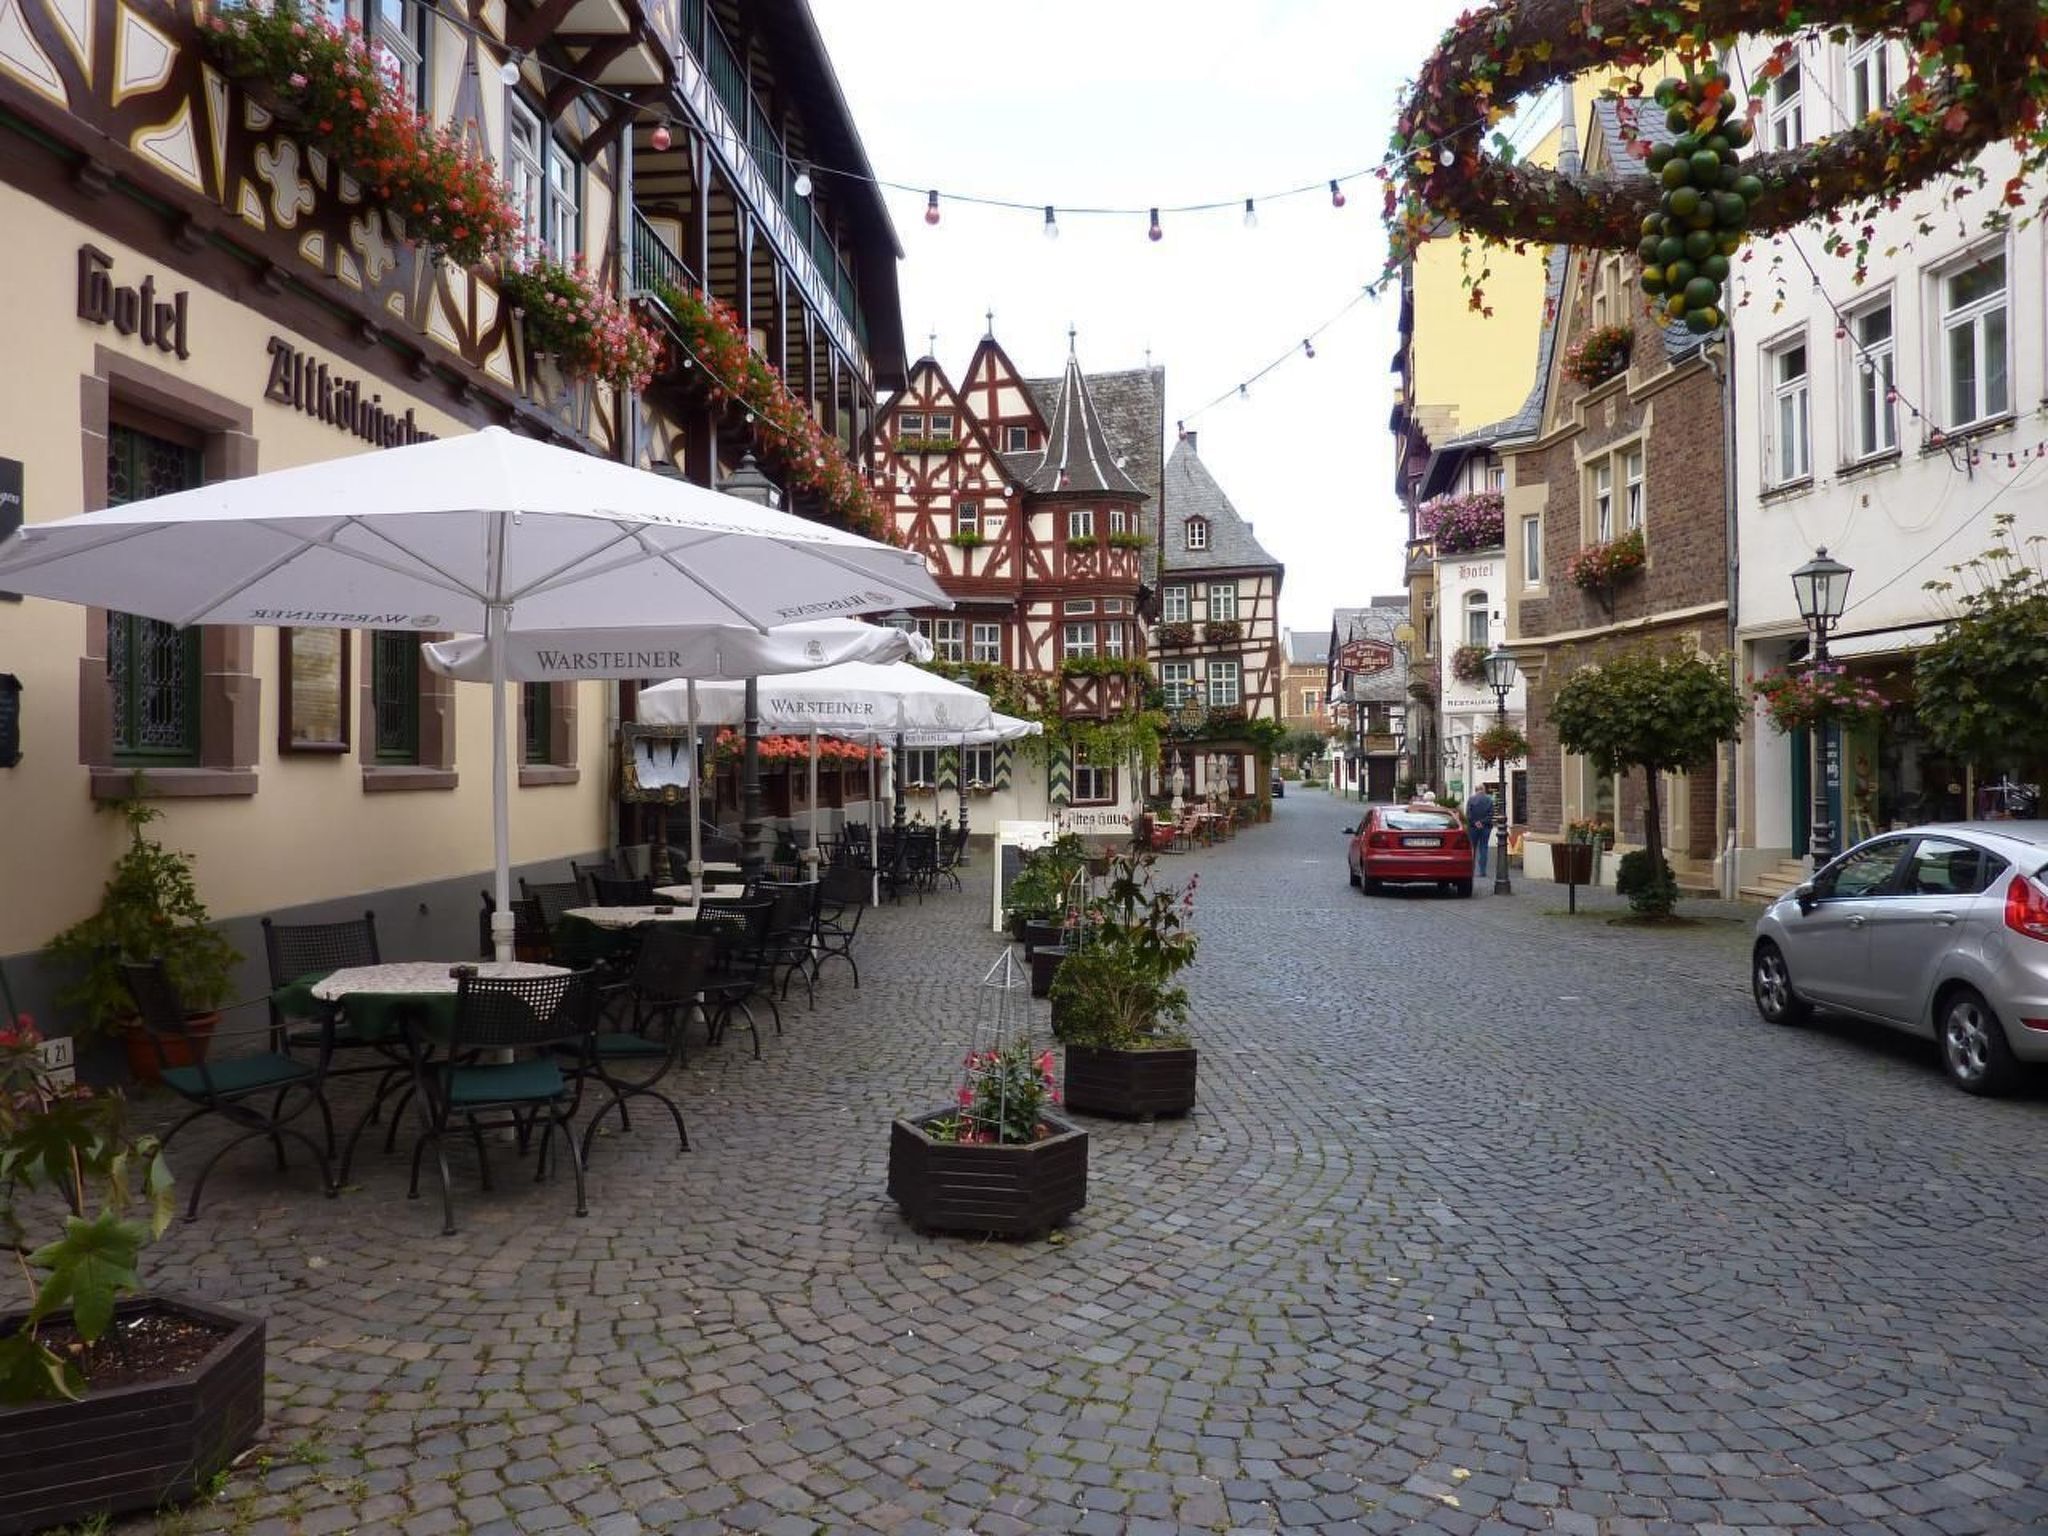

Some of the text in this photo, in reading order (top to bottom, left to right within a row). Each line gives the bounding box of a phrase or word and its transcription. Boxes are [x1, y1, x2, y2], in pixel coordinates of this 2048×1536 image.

[77, 243, 190, 361] Hotel
[264, 335, 440, 449] Altkölnisch
[1458, 562, 1494, 580] Hotel
[536, 650, 682, 671] WARSTEINER
[770, 698, 874, 715] WARSTEINER
